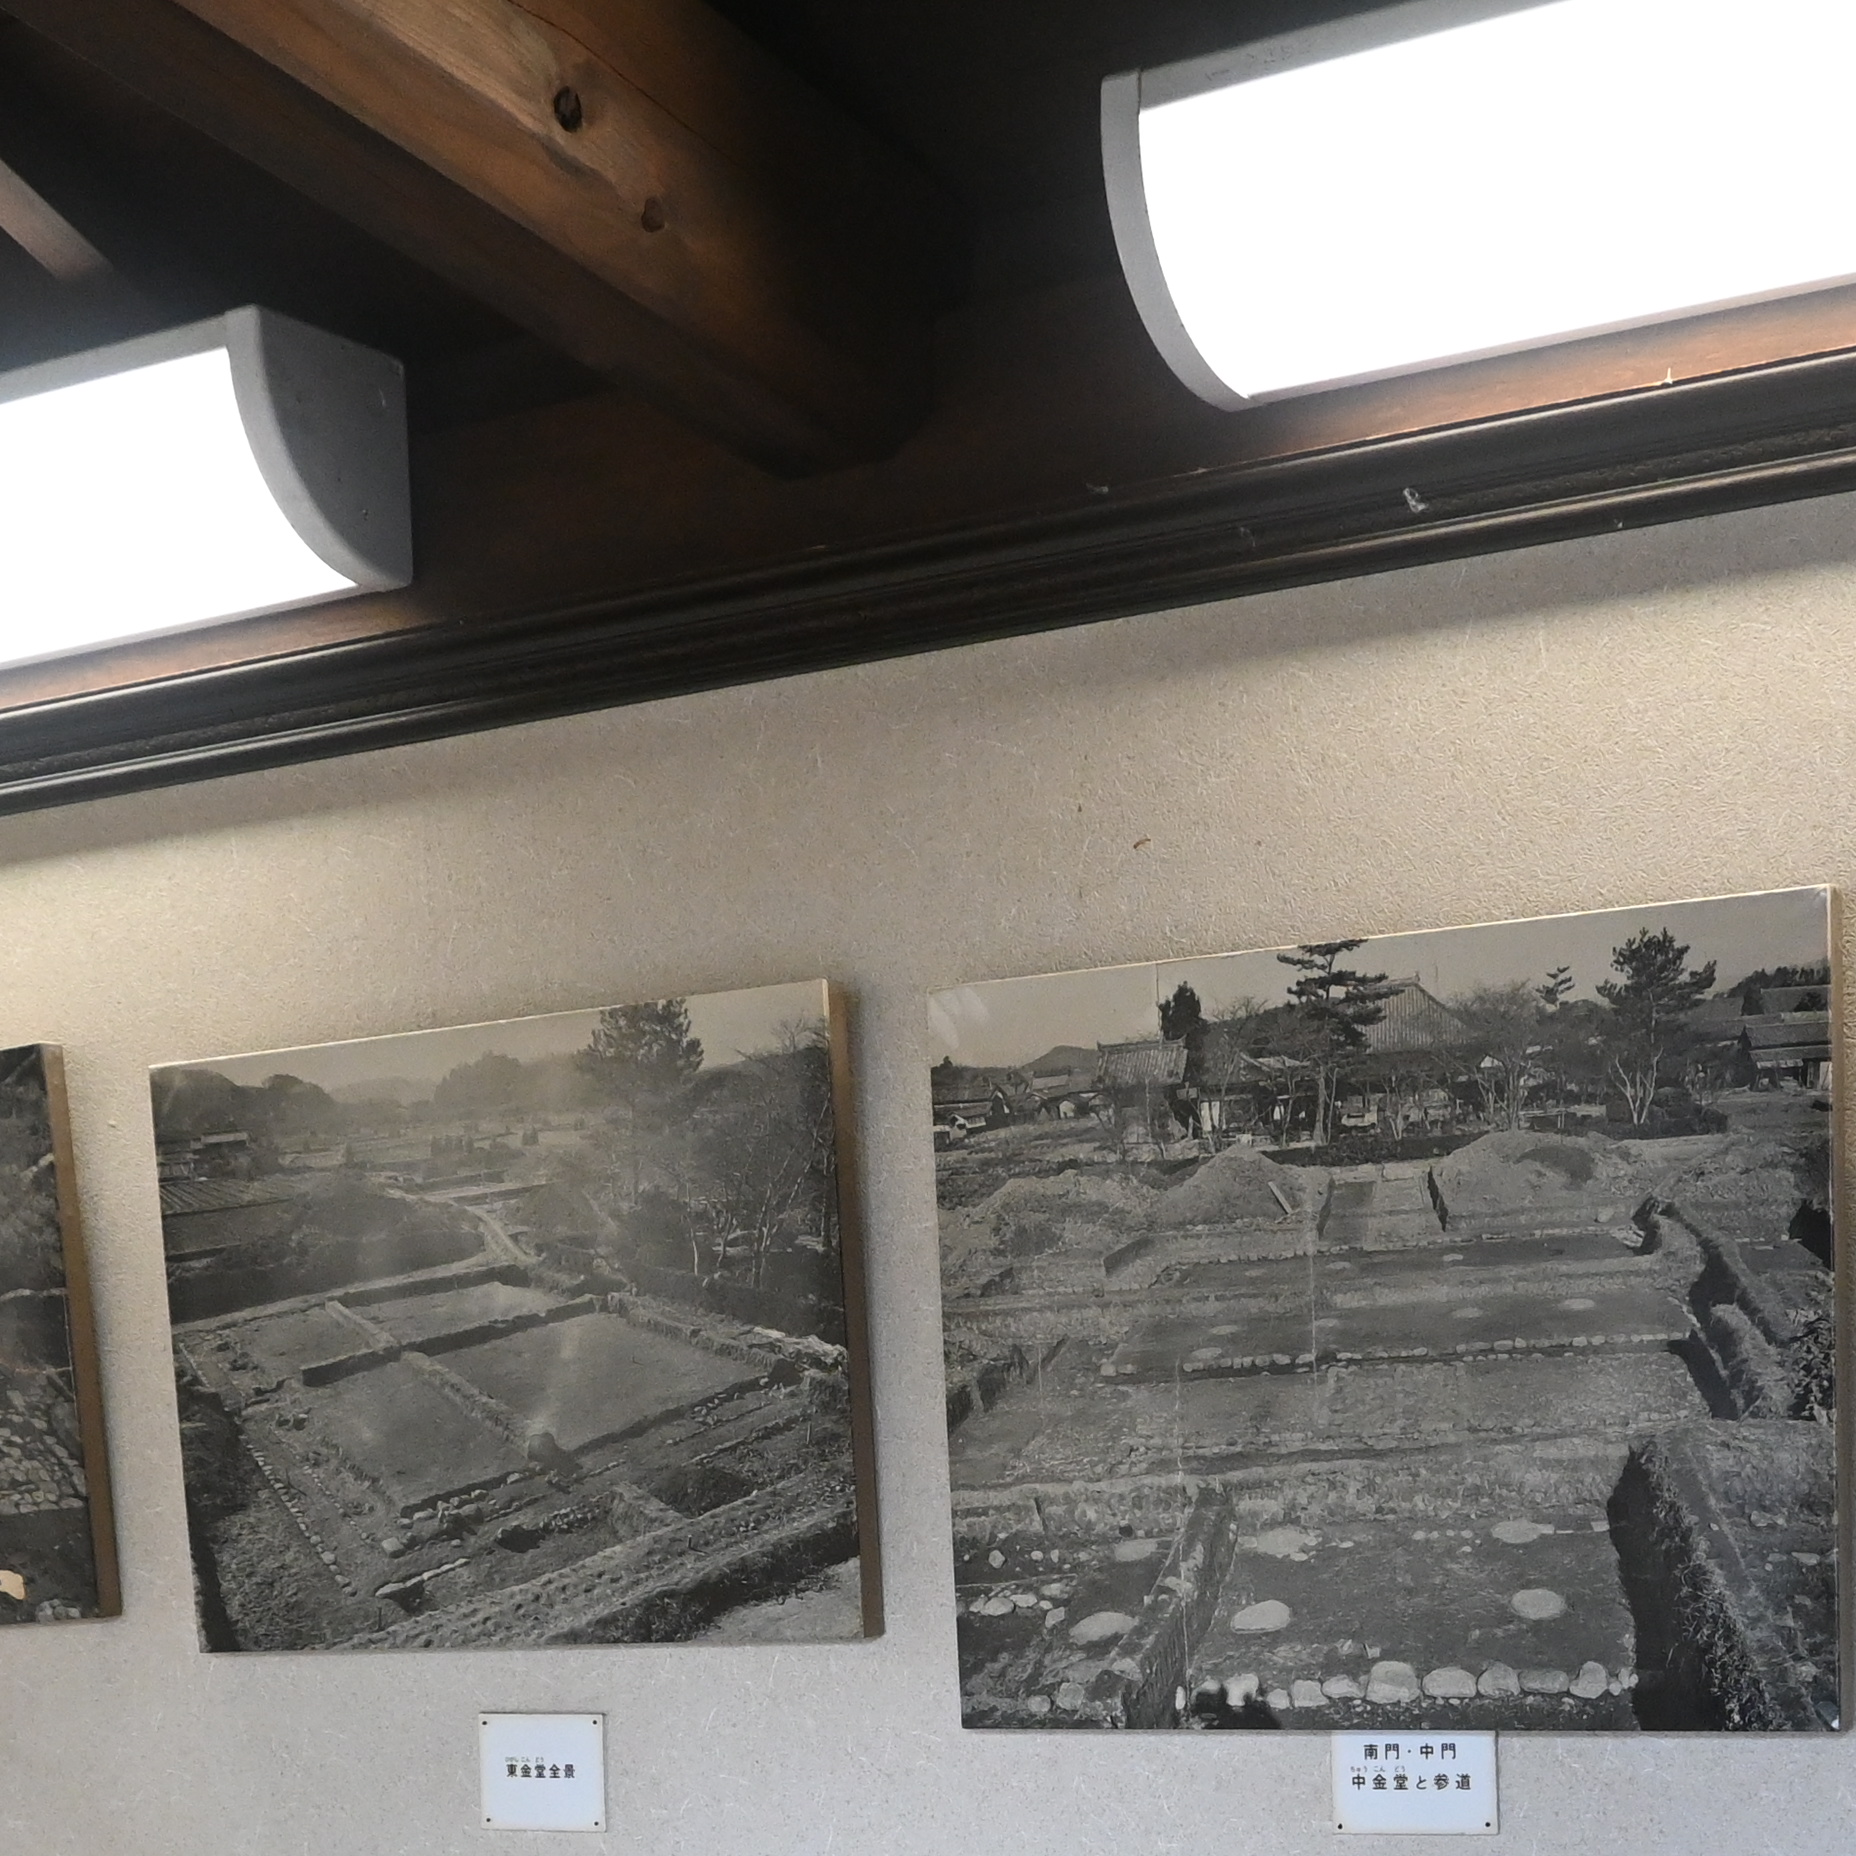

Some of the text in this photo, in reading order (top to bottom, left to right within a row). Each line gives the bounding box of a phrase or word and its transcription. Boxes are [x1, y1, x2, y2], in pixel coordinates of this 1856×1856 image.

[1363, 1743, 1457, 1760] 南門・中門
[506, 1764, 575, 1779] 東金堂全景
[1352, 1773, 1472, 1791] 中金堂と参道
